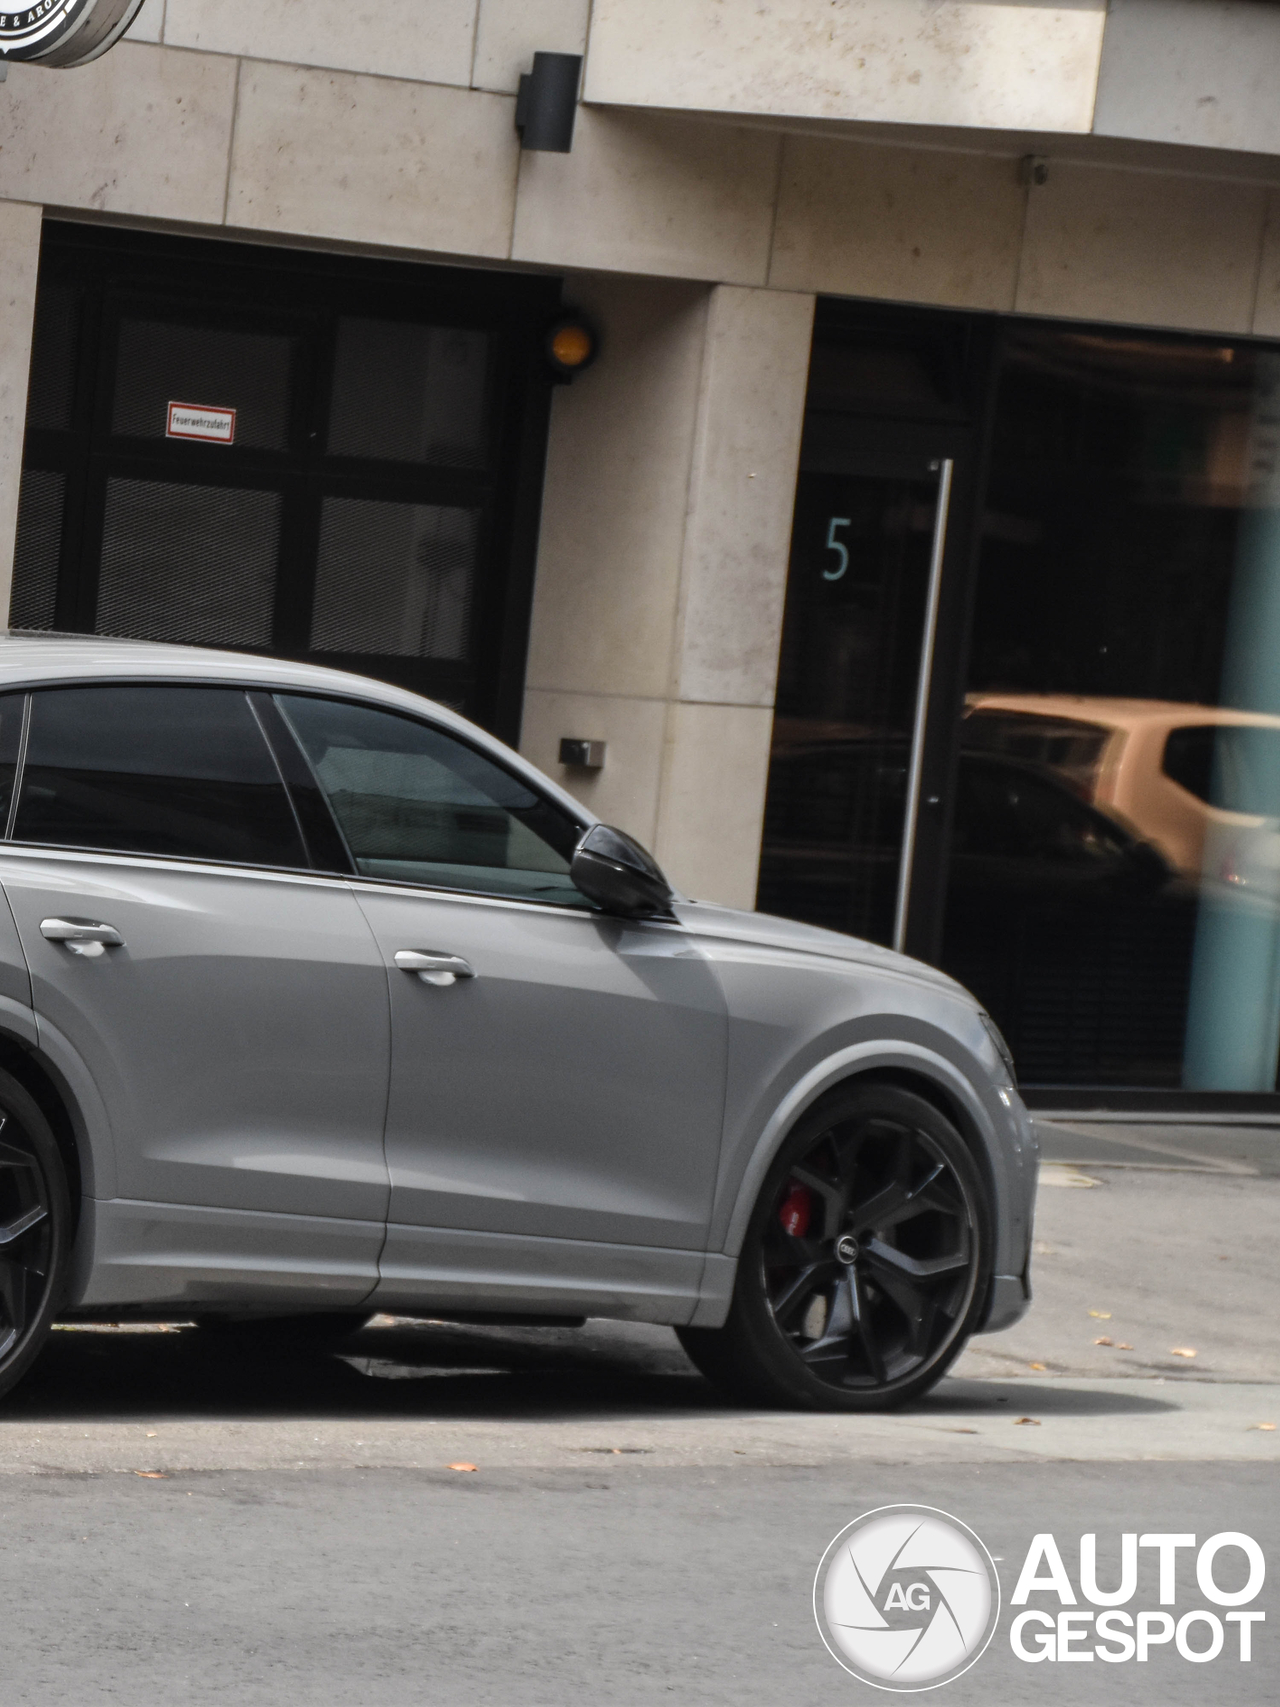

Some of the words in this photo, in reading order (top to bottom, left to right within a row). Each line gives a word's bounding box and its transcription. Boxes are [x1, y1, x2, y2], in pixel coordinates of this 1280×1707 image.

[13, 16, 20, 27] &
[172, 412, 230, 431] Feuerwehrzufahrt
[823, 517, 851, 580] 5
